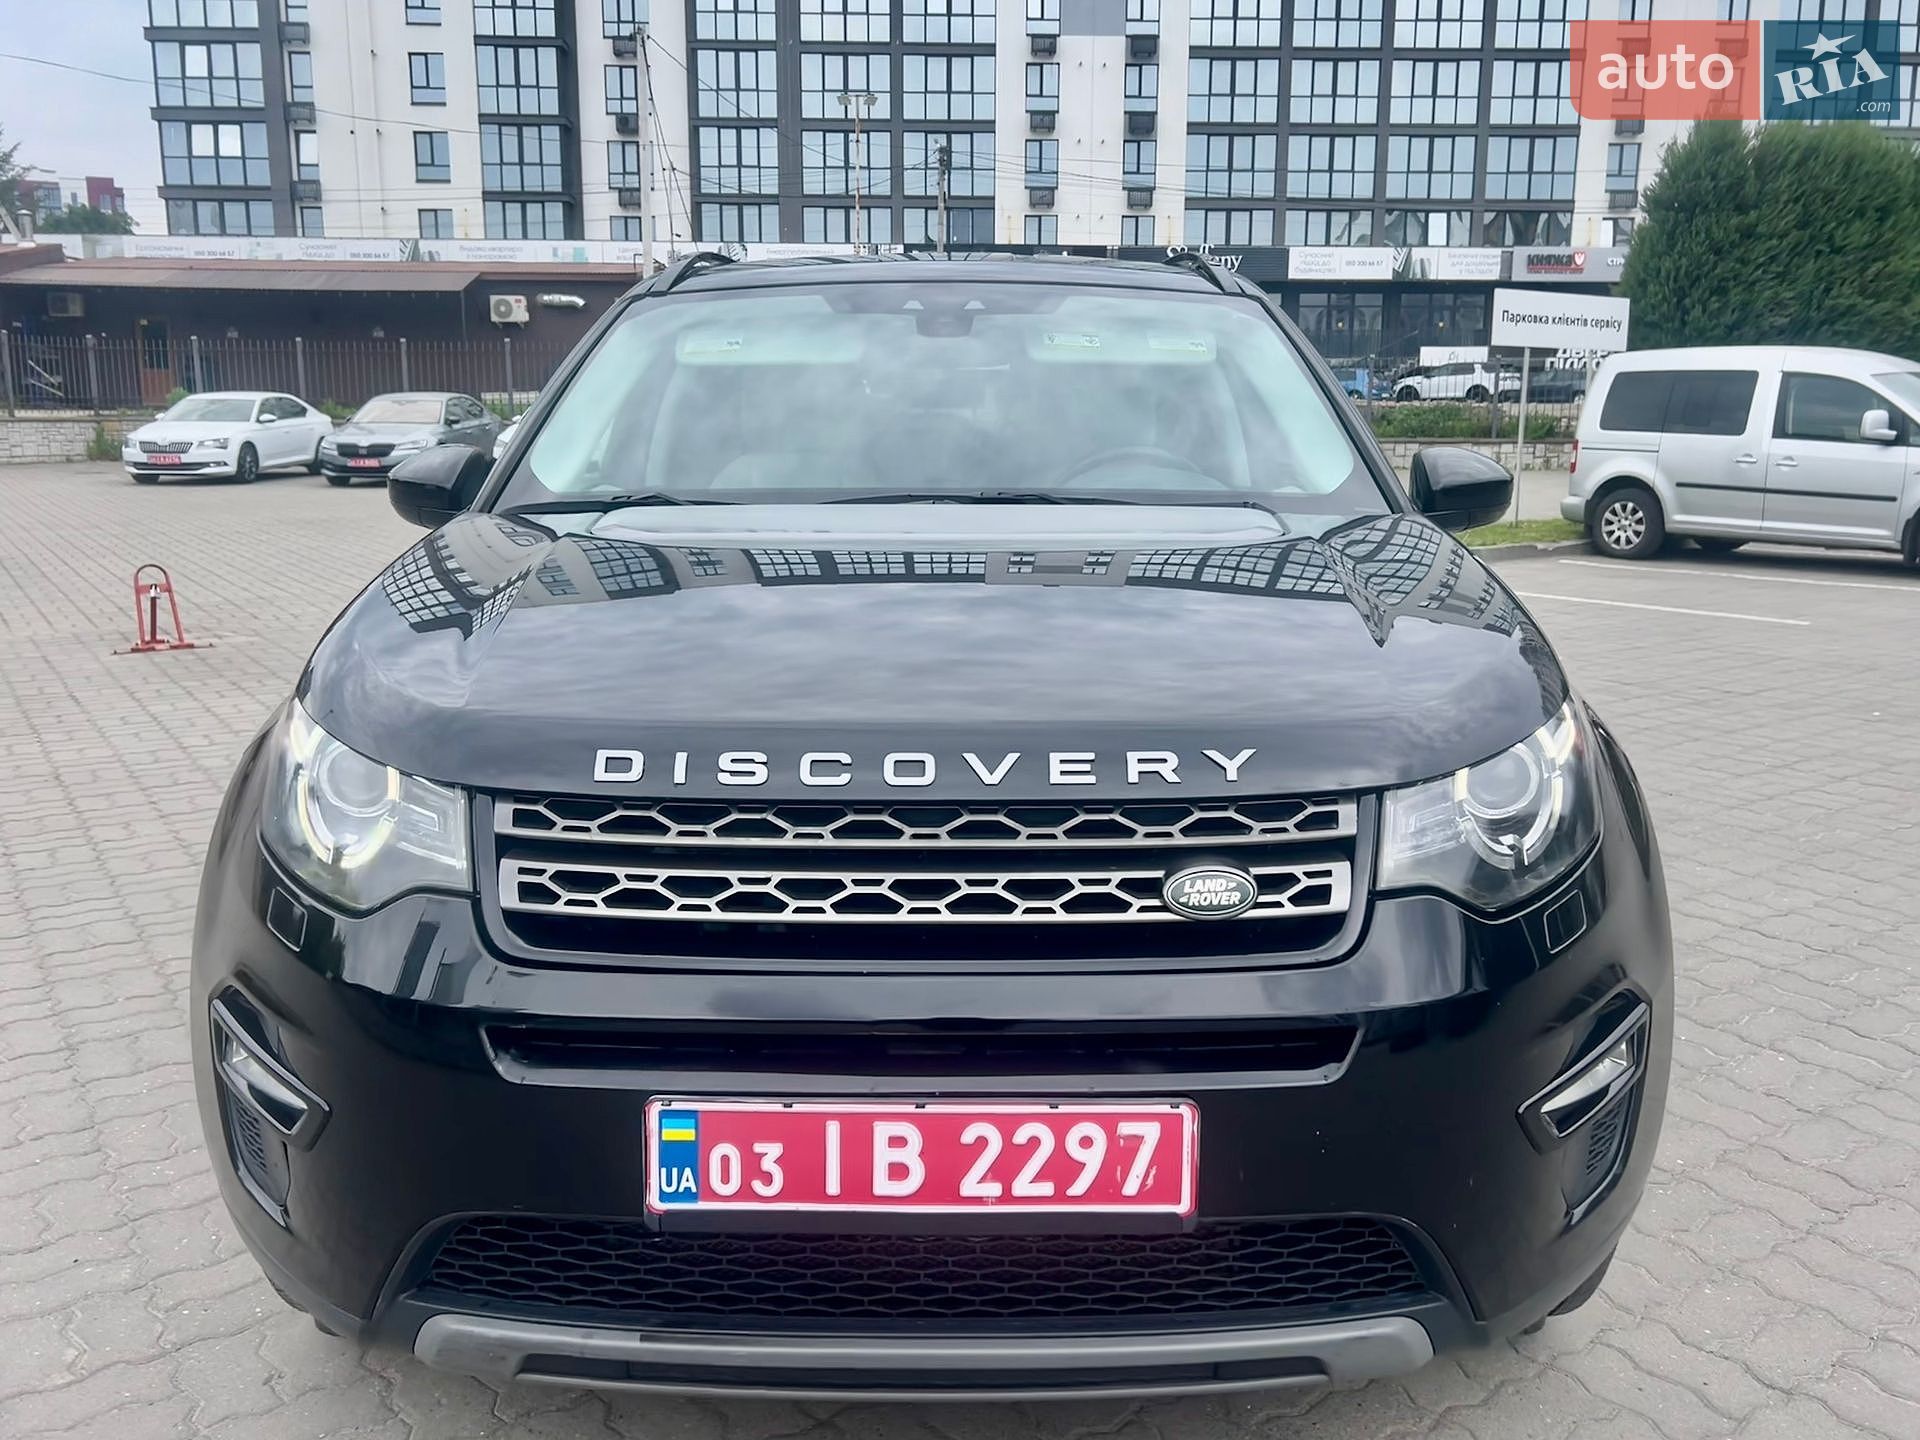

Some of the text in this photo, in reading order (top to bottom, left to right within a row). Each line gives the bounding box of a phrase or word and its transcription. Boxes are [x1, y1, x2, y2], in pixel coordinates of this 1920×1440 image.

[1502, 309, 1623, 332] Парковка клієнтів сервісу
[593, 748, 1258, 786] DISCOVERY
[1183, 878, 1227, 893] LAND
[1188, 891, 1241, 906] ROVER
[708, 1142, 785, 1197] 03
[959, 1121, 1161, 1197] 2297
[660, 1167, 698, 1193] UA
